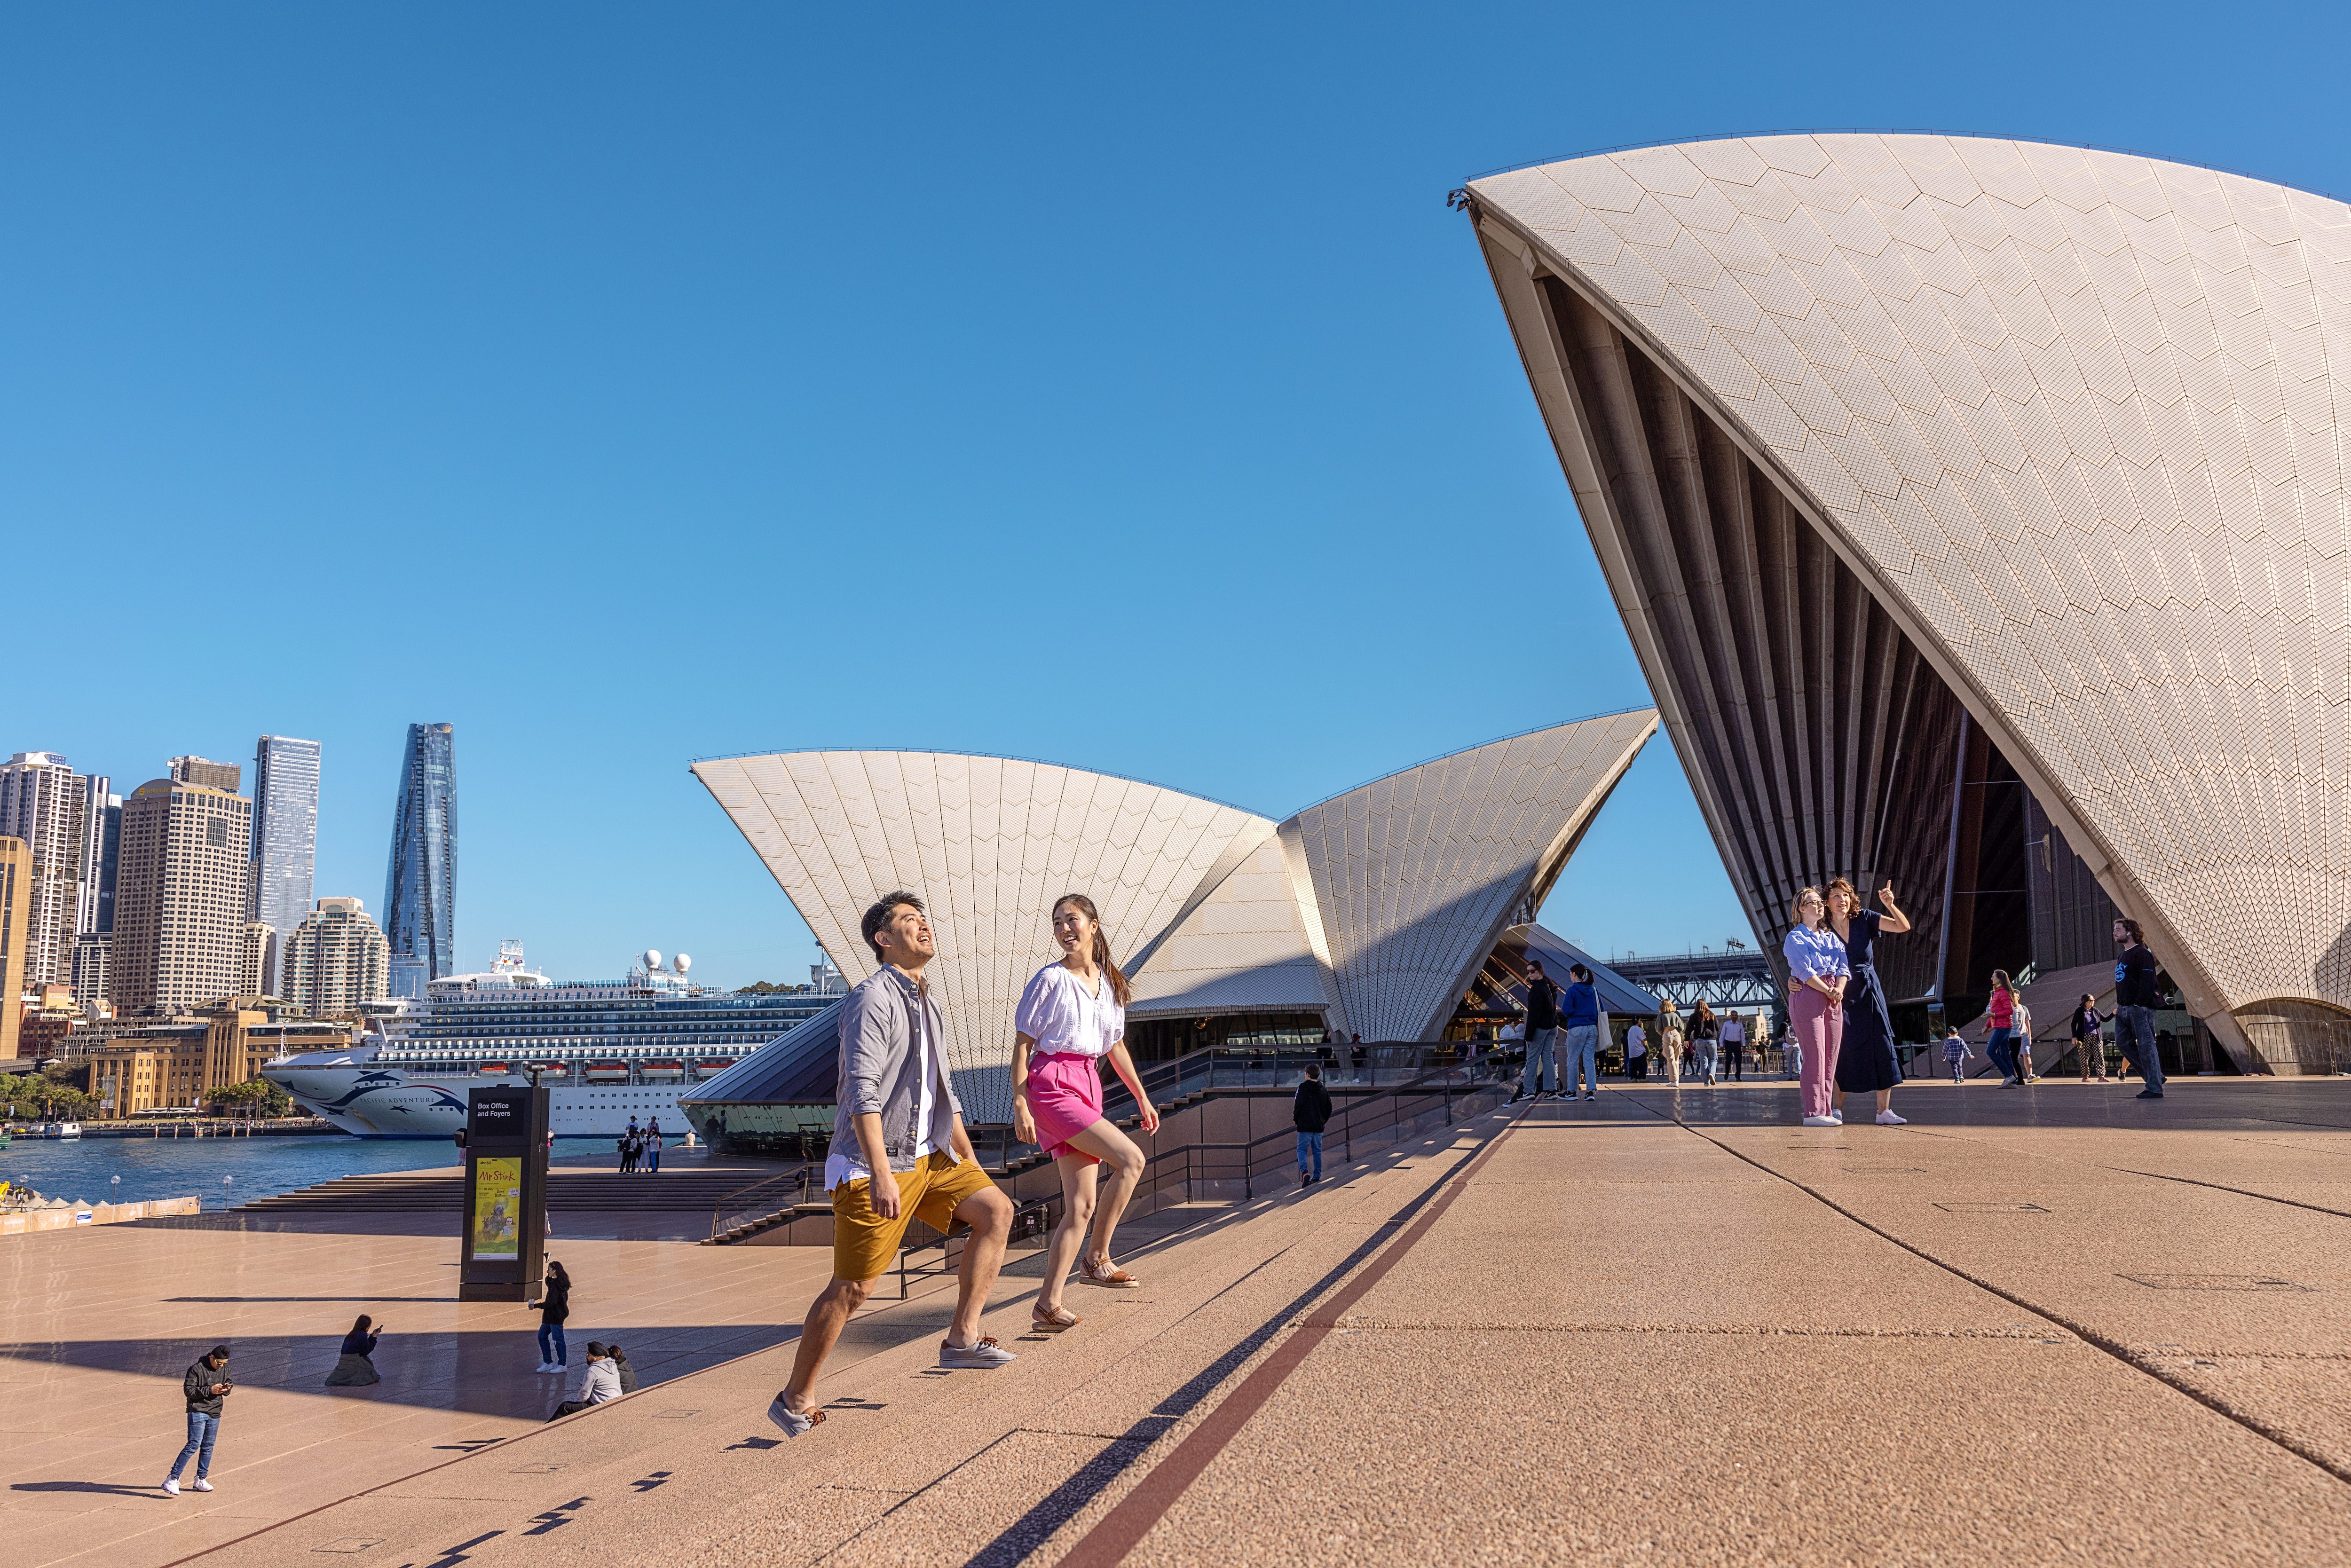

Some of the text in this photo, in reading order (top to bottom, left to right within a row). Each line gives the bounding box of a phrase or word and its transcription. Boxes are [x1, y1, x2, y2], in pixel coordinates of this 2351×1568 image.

[189, 788, 226, 798] SHANGRI-LA
[479, 1170, 515, 1181] Mr Stink
